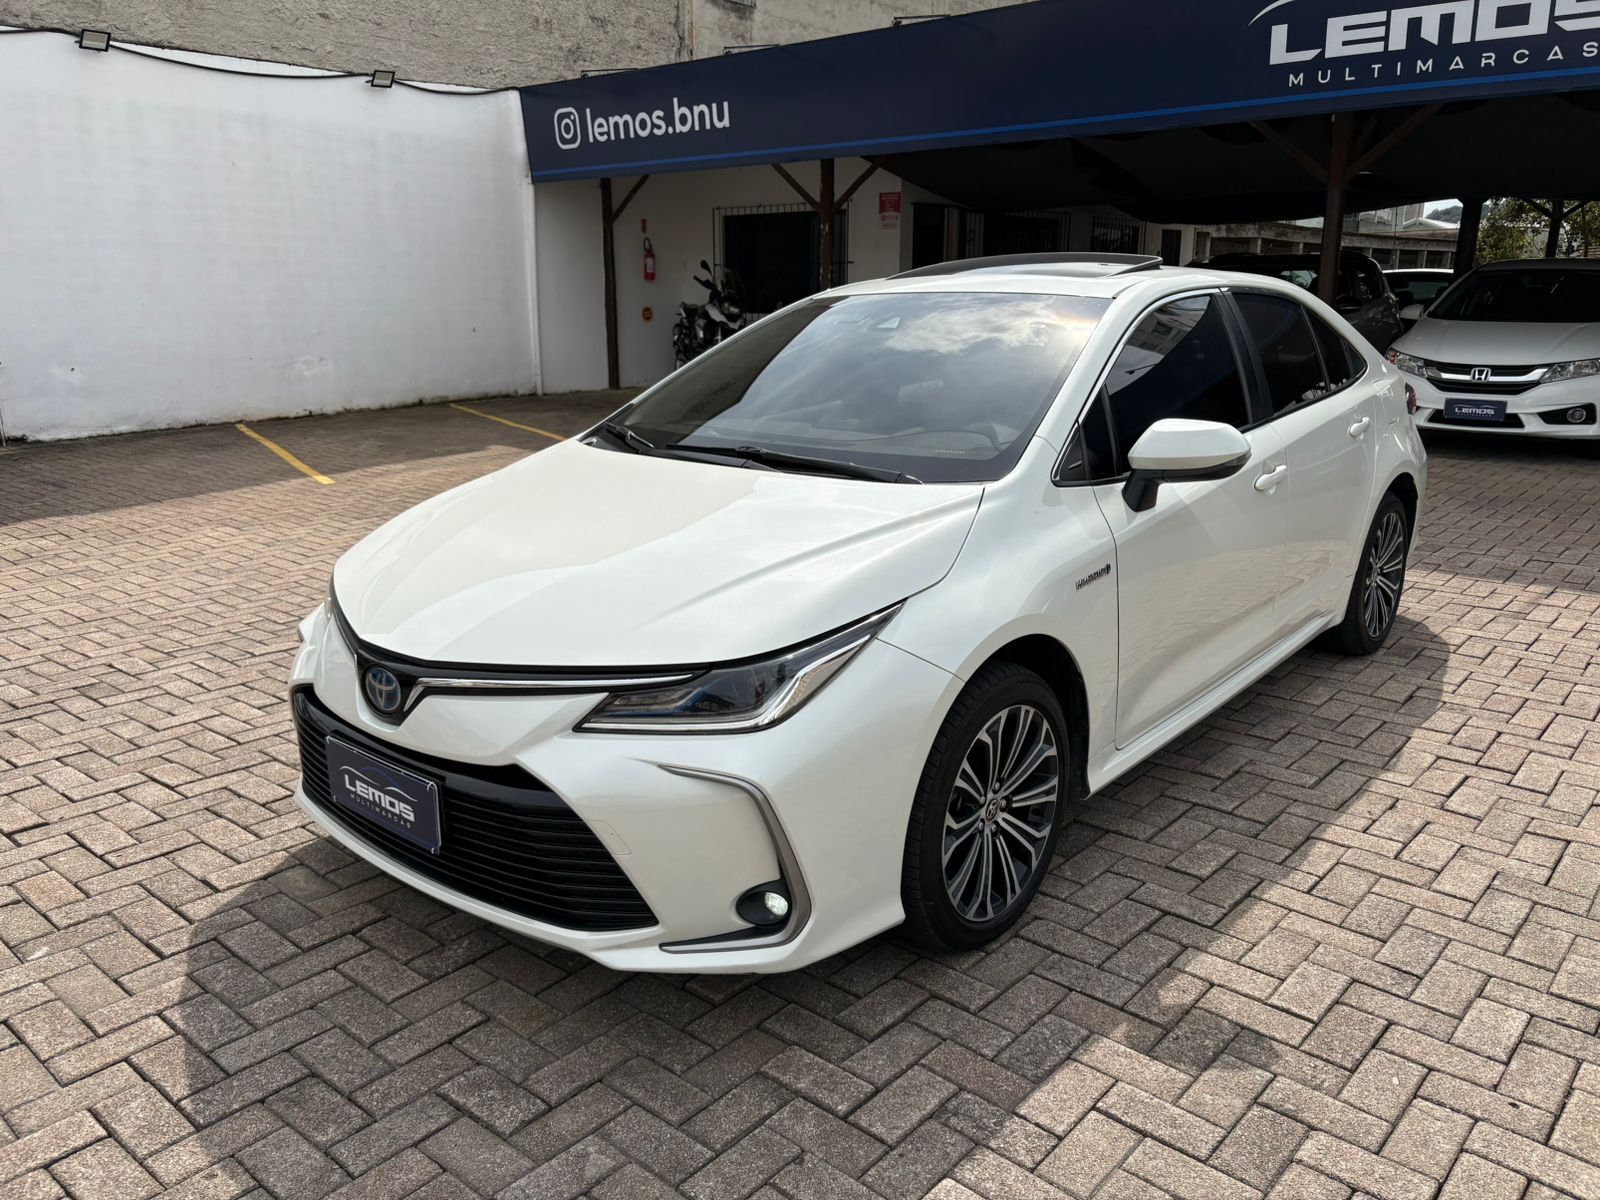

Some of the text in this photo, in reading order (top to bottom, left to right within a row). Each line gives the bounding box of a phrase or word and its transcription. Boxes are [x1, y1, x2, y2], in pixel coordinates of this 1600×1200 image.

[1288, 42, 1600, 88] MULTIMARCAS
[585, 97, 731, 143] lemos.bnu
[1454, 407, 1496, 415] LEMOS
[344, 774, 415, 822] LEMOS
